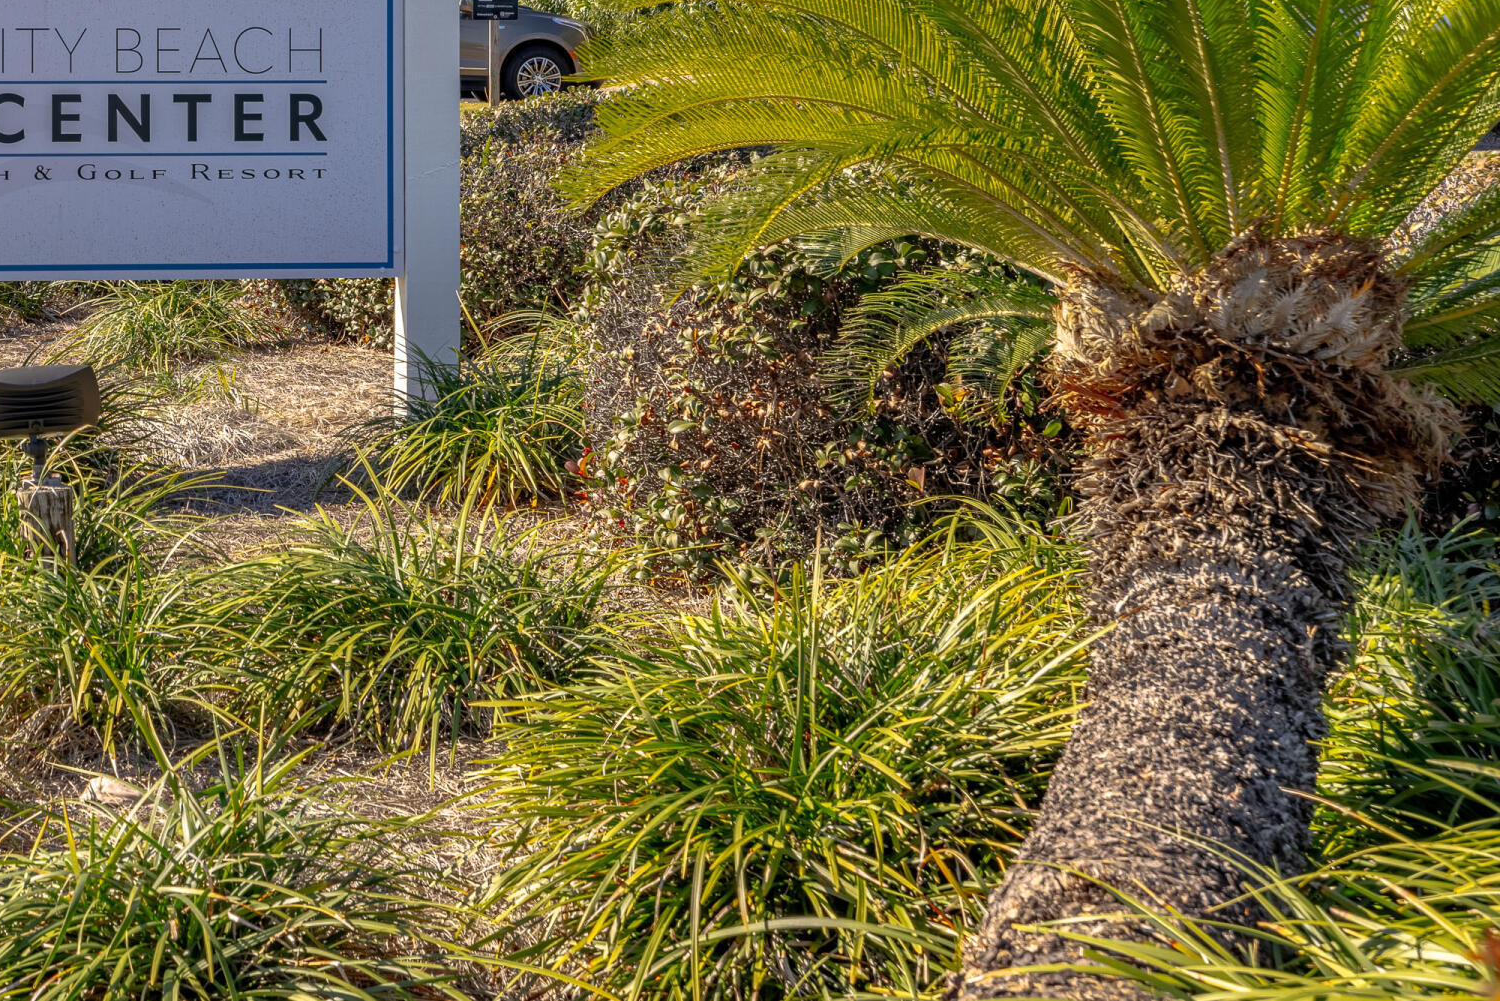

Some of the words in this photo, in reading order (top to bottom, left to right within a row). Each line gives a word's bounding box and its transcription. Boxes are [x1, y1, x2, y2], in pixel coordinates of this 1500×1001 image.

[115, 26, 324, 75] BEACH
[33, 164, 53, 182] &
[77, 163, 167, 181] GOLF
[190, 162, 328, 181] RESORT
